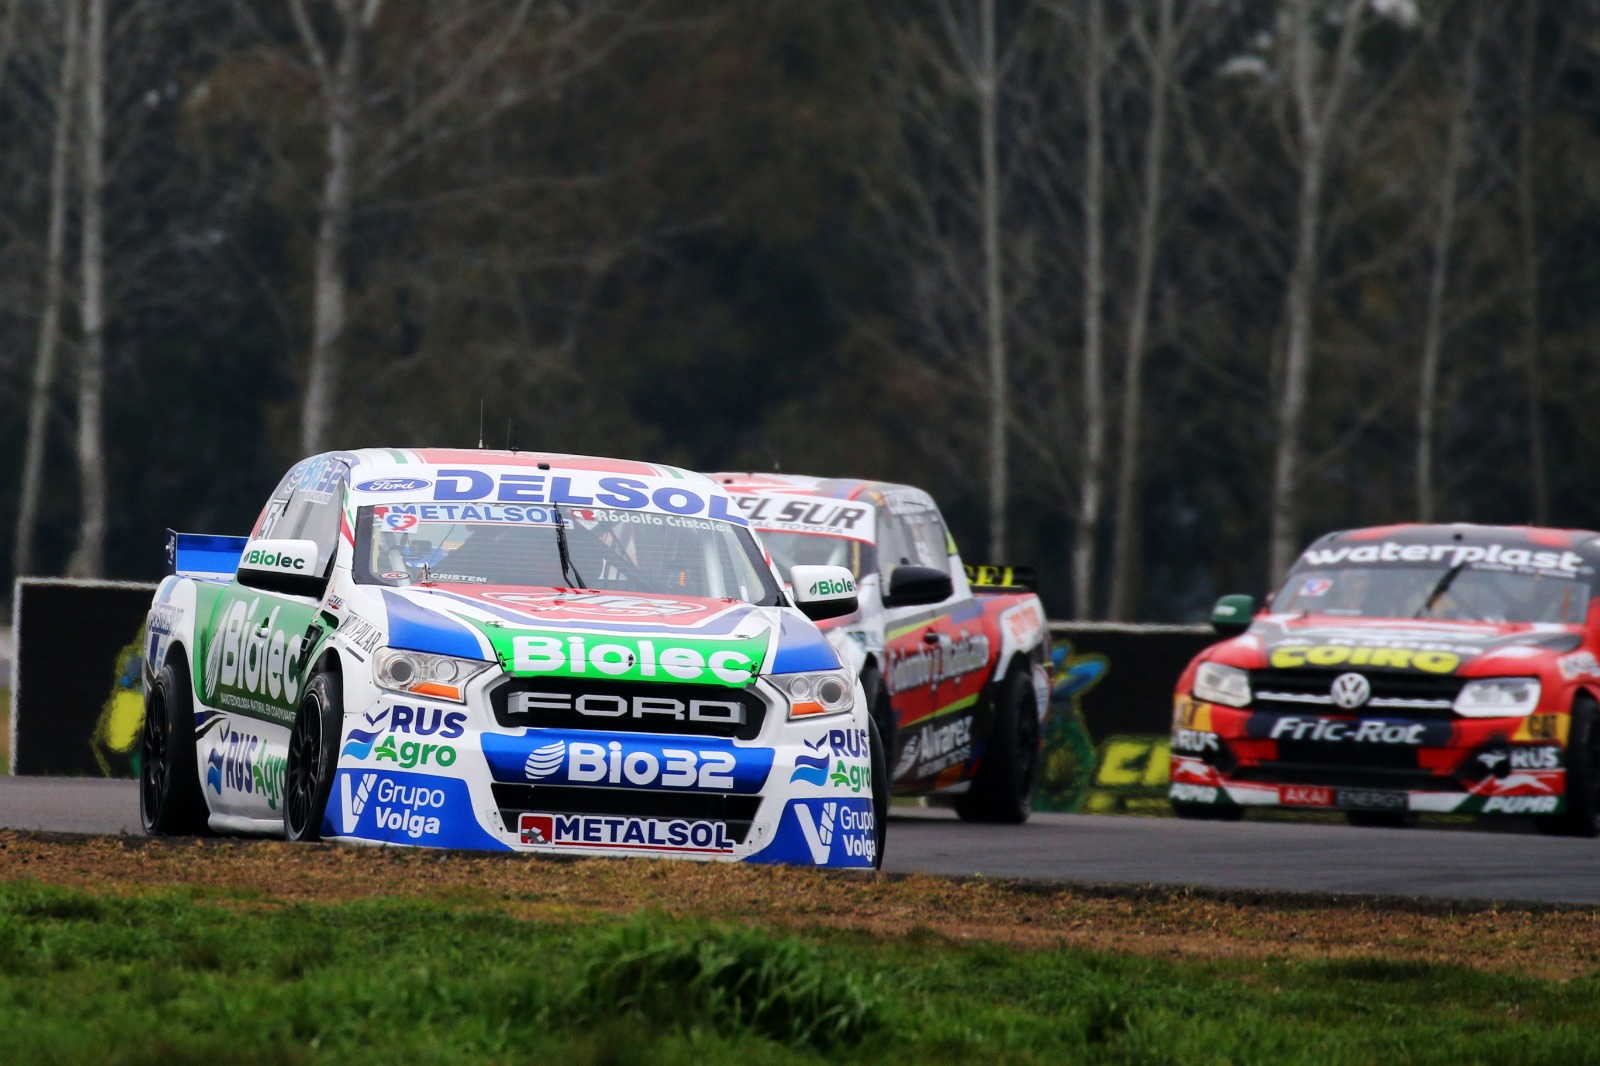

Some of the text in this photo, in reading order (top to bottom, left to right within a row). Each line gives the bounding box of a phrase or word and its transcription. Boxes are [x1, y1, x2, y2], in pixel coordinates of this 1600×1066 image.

[433, 469, 749, 527] DELSOL
[391, 504, 571, 525] METALSOL
[666, 514, 732, 533] Cristales
[775, 500, 867, 530] SUR
[780, 522, 843, 534] TOYOTA
[249, 550, 305, 570] Biolec
[1302, 541, 1583, 572] waterplast
[430, 572, 488, 583] CRISTEM
[221, 597, 301, 704] Biolec
[512, 635, 754, 684] Biolec
[1270, 645, 1461, 674] COIRO
[389, 705, 468, 738] RUS
[508, 690, 747, 725] FORD
[829, 728, 869, 758] RUS
[1269, 717, 1427, 744] Fric-Rot
[226, 730, 258, 794] RUS
[374, 735, 457, 769] Agro
[567, 740, 737, 789] Bio32
[1510, 746, 1559, 768] RUS
[830, 759, 871, 793] Agro
[378, 779, 445, 811] Grupo
[1285, 788, 1330, 804] AKAI
[375, 806, 441, 838] Volga
[554, 814, 735, 848] METALSOL
[840, 806, 874, 835] Grupo
[842, 834, 876, 863] Volga
